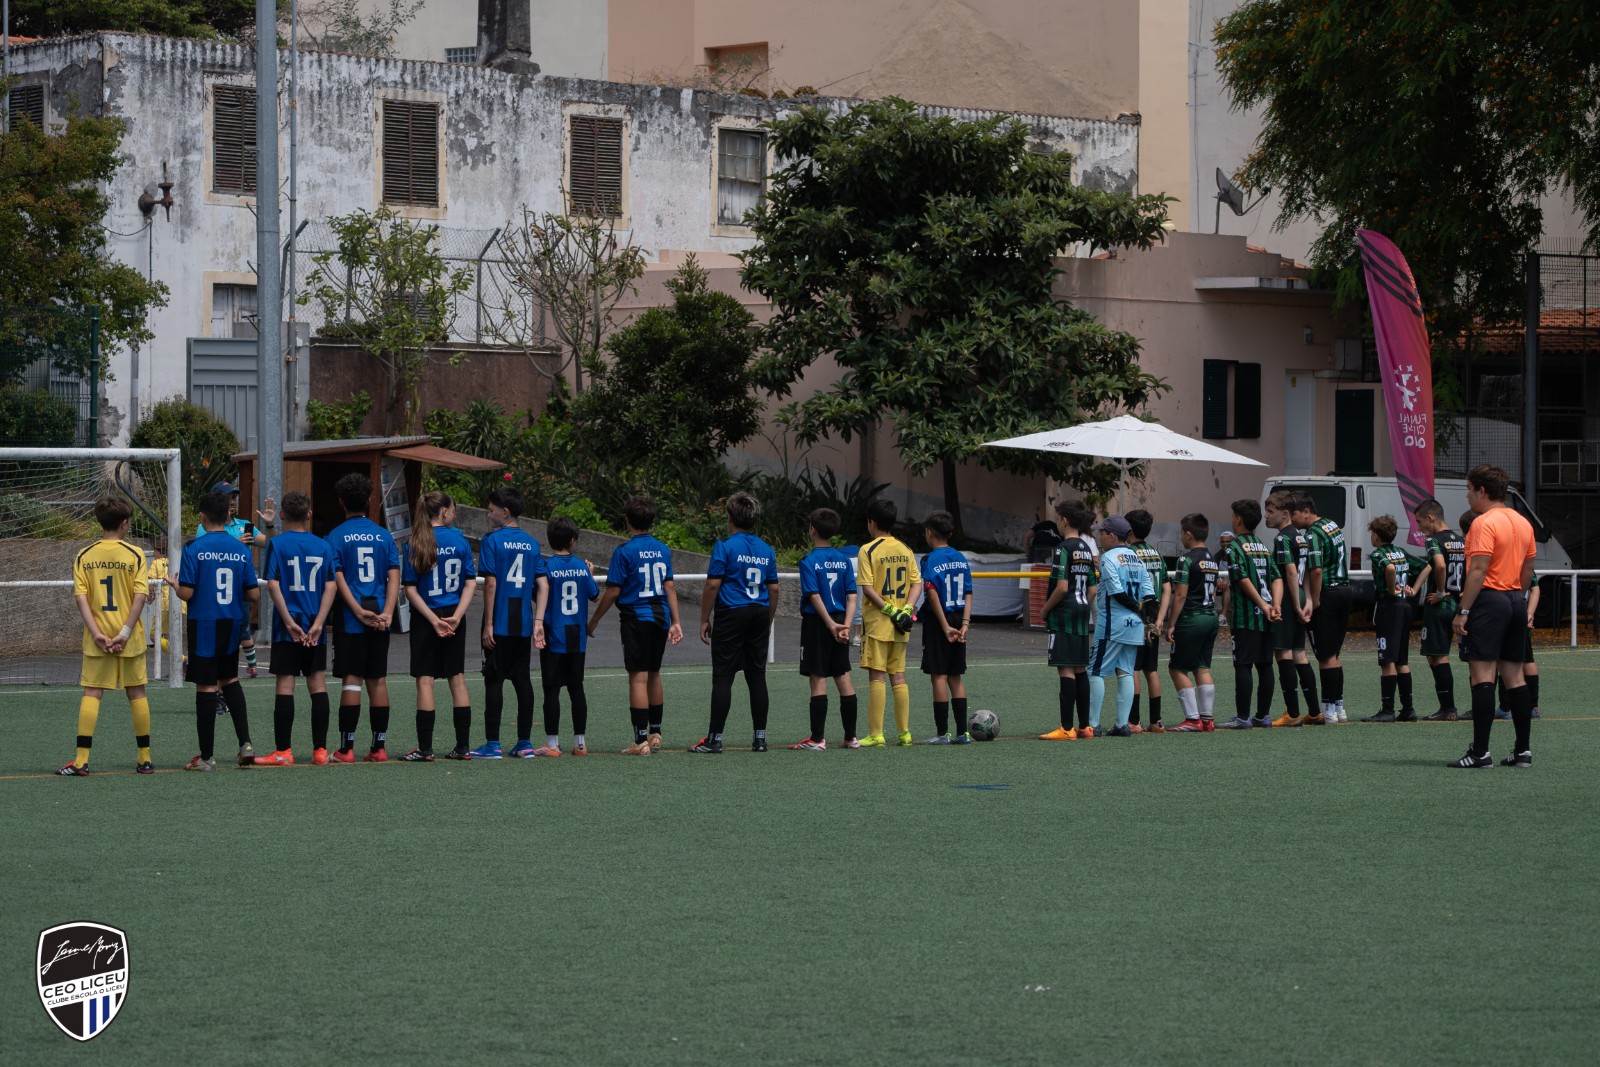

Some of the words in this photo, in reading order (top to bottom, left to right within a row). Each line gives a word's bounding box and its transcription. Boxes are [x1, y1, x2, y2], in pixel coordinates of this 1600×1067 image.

[344, 533, 374, 543] DIOGO
[503, 541, 532, 551] MARCO
[639, 551, 662, 559] ROCHA
[82, 561, 126, 571] SALVADOR
[197, 552, 240, 562] GONÇALO
[288, 556, 323, 592] 17
[357, 547, 375, 583] 5
[506, 553, 526, 588] 4
[737, 555, 769, 566] ANDRADE
[814, 562, 823, 570] A.
[100, 575, 118, 611] 1
[216, 567, 233, 605] 9
[428, 558, 462, 597] 18
[638, 562, 667, 598] 10
[746, 567, 761, 599] 3
[826, 572, 838, 606] 7
[882, 566, 907, 599] 42
[945, 573, 966, 607] 11
[561, 580, 578, 615] 8
